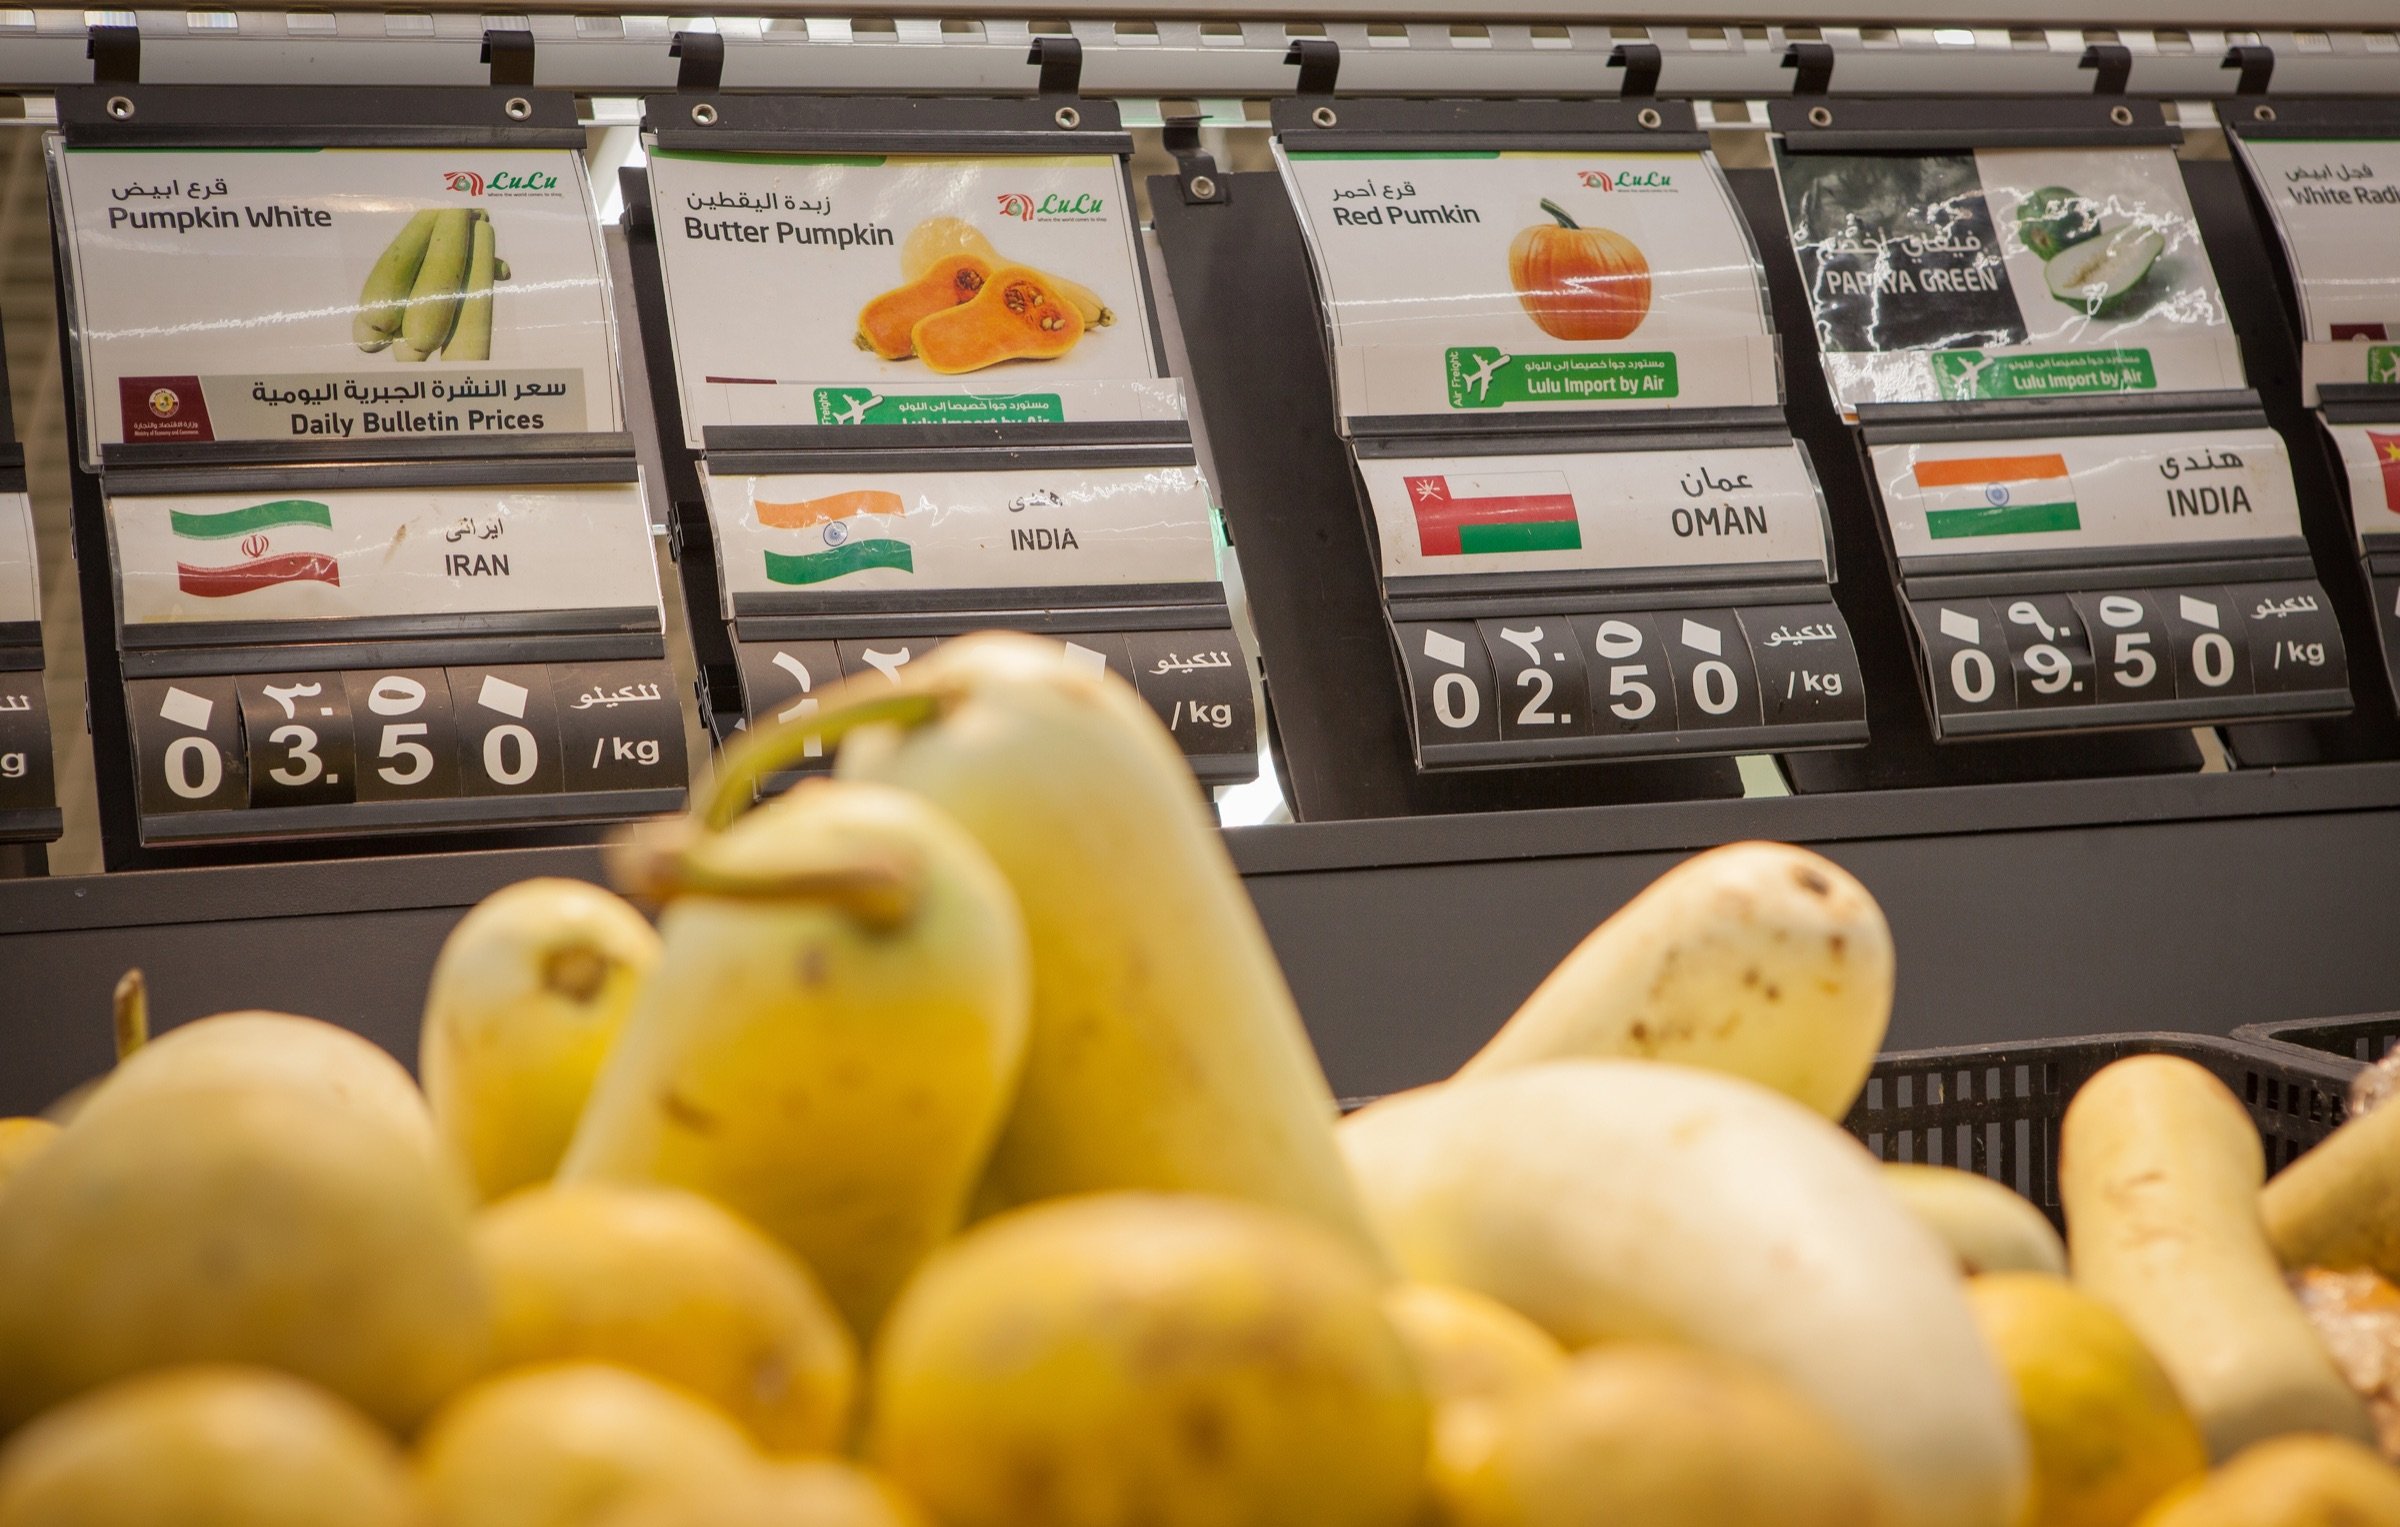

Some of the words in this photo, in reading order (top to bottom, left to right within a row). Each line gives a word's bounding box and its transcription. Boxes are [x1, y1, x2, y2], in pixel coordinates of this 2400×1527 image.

[187, 178, 228, 200] قرع
[486, 171, 558, 190] LuLu
[1333, 179, 1377, 201] أحمر
[1382, 181, 1417, 200] قرع
[1614, 171, 1671, 187] LuLu
[686, 191, 778, 213] اليقطين
[784, 195, 831, 216] زبدة
[1036, 193, 1103, 214] LuLu
[2287, 185, 2353, 205] White
[108, 206, 240, 234] Pumpkin
[245, 205, 332, 228] White
[1332, 206, 1384, 226] Red
[1386, 204, 1481, 225] Pumkin
[684, 216, 770, 243] Butter
[776, 222, 894, 250] Pumpkin
[1918, 266, 1999, 293] GREEN
[431, 376, 507, 402] النشرة
[1527, 377, 1560, 394] Lulu
[1564, 377, 1616, 396] Import
[1619, 376, 1638, 395] by
[1643, 375, 1665, 391] Air
[2012, 374, 2046, 390] Lulu
[2047, 371, 2098, 390] Import
[2100, 370, 2119, 388] by
[2121, 368, 2143, 384] Air
[252, 381, 338, 406] اليومية
[343, 379, 426, 404] الجبرية
[513, 382, 566, 401] سعر
[291, 411, 354, 437] Daily
[363, 410, 459, 433] Bulletin
[468, 409, 544, 431] Prices
[1680, 466, 1753, 498] عمان
[2166, 485, 2252, 518] INDIA
[1671, 505, 1768, 538] OMAN
[1010, 527, 1079, 551] INDIA
[445, 553, 510, 577] IRAN
[2250, 595, 2319, 620] للكيلو
[1763, 623, 1838, 647] للكيلو
[1148, 650, 1232, 675] للكيلو
[569, 683, 662, 710] للكيلو
